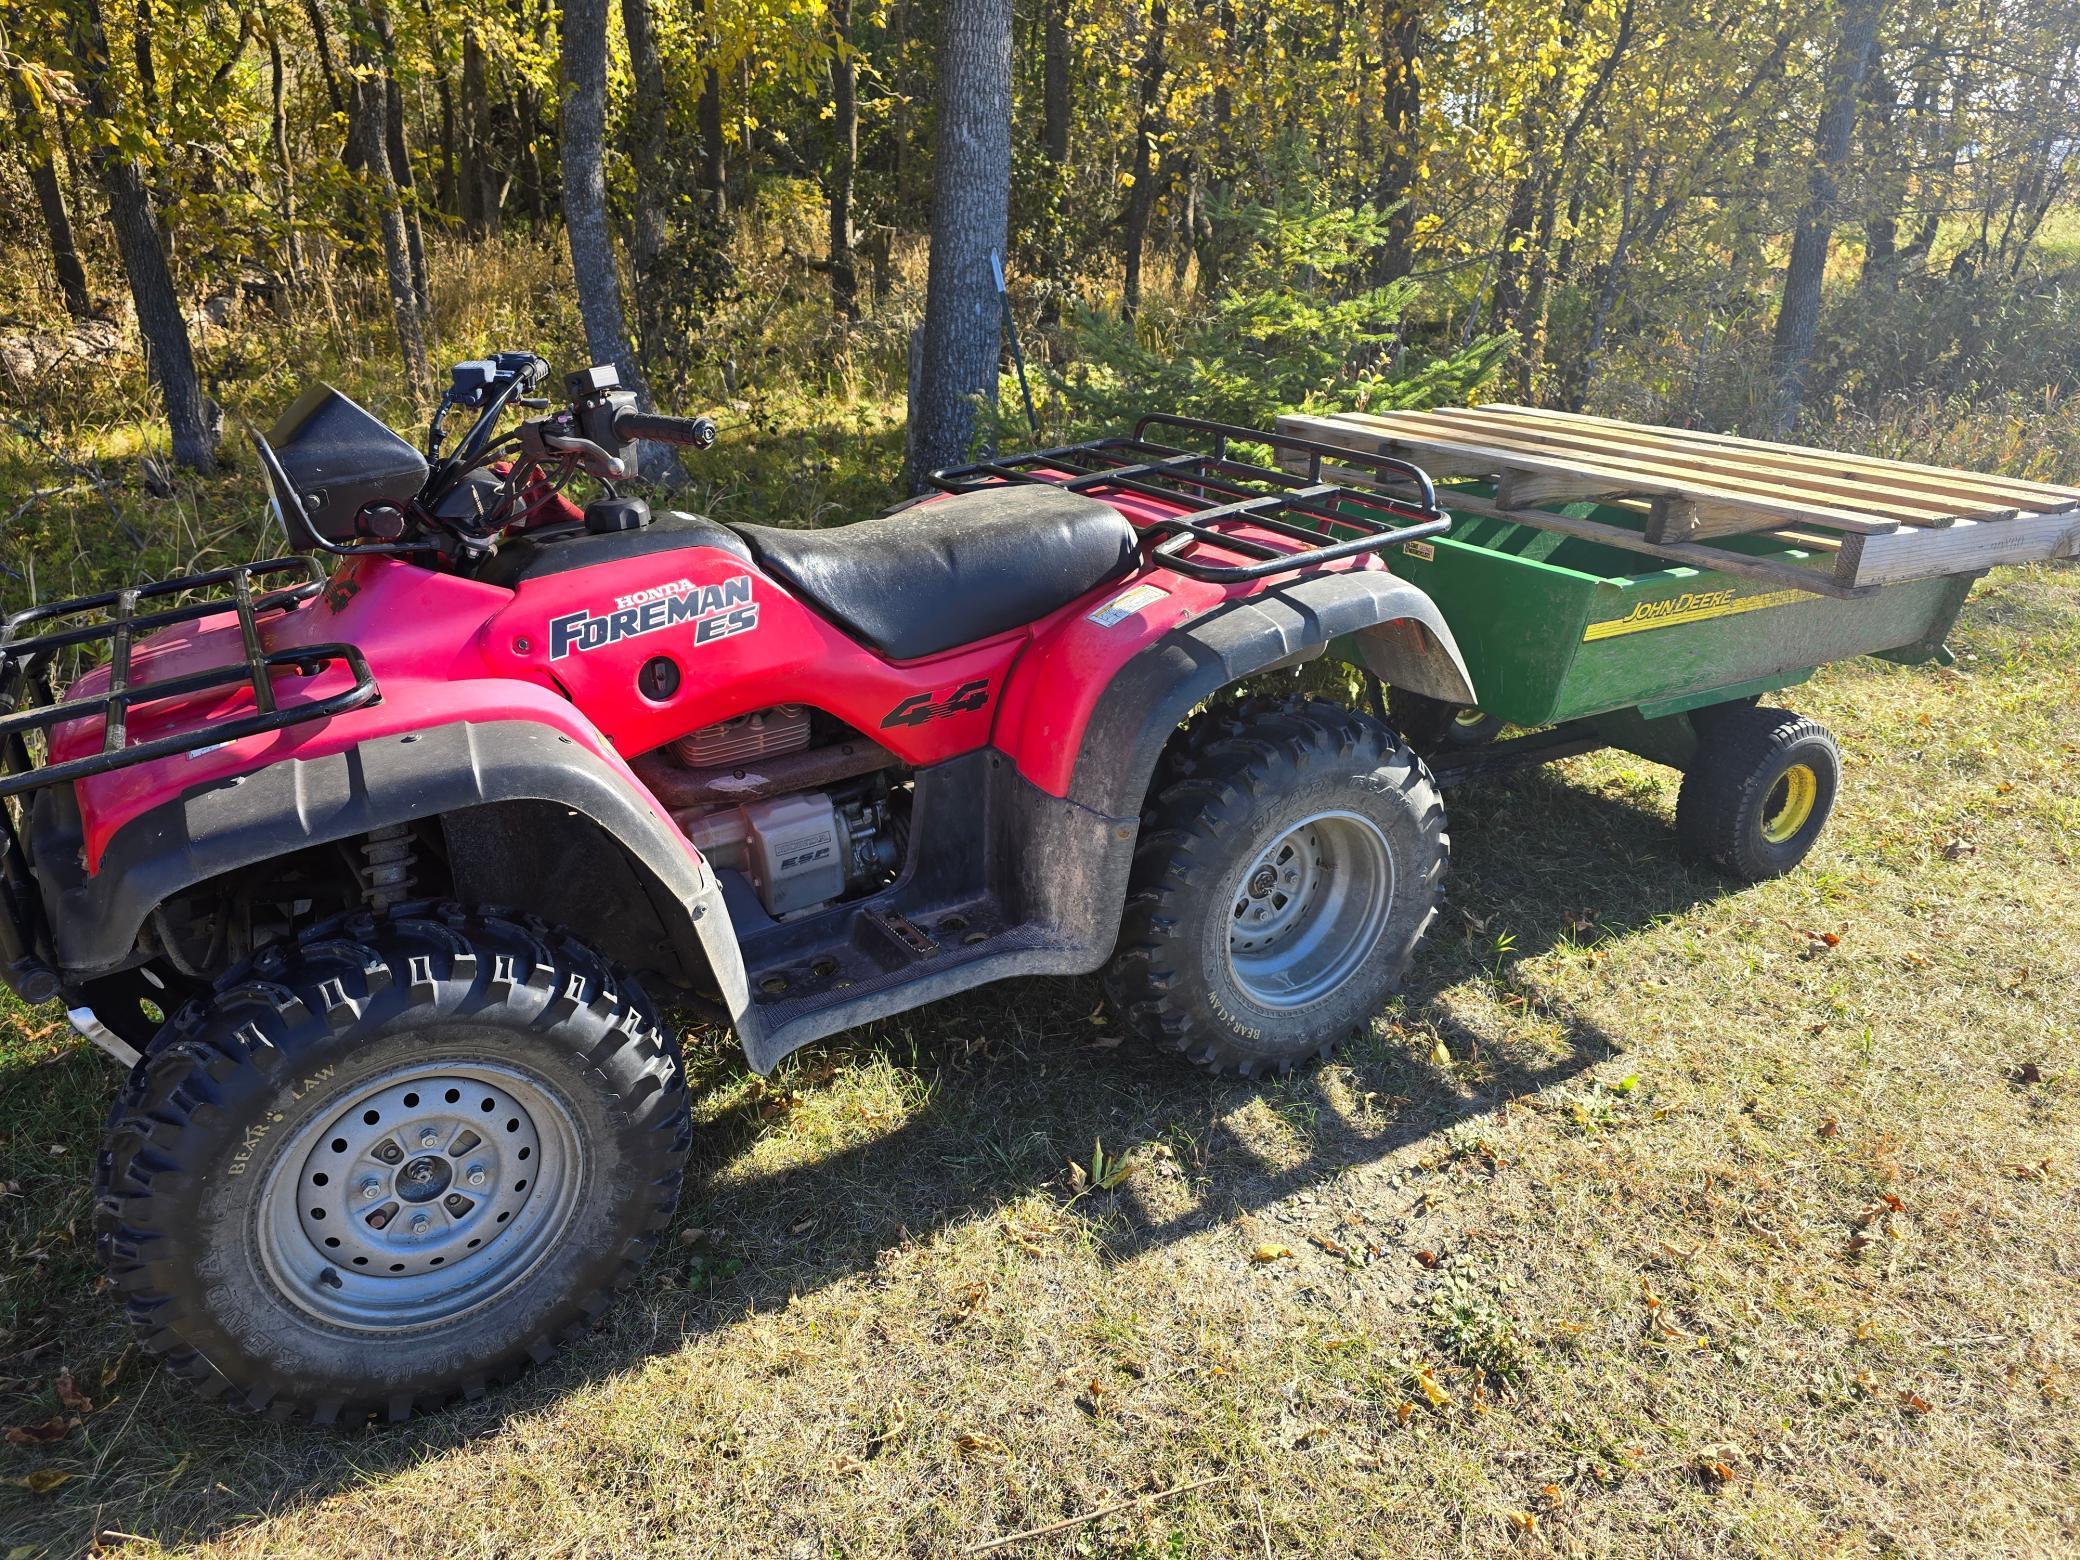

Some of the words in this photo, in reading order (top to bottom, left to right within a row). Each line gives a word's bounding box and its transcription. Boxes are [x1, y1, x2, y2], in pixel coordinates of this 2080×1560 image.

[614, 578, 697, 610] HONDA
[1622, 597, 1675, 623] JOHN
[1675, 588, 1737, 613] DEERE
[549, 575, 753, 662] FOREMAN
[693, 603, 760, 647] ES
[1207, 990, 1228, 1021] CLAW
[1233, 1022, 1261, 1040] BEAR
[228, 1125, 270, 1175] BEAR
[289, 1064, 337, 1105] LAW
